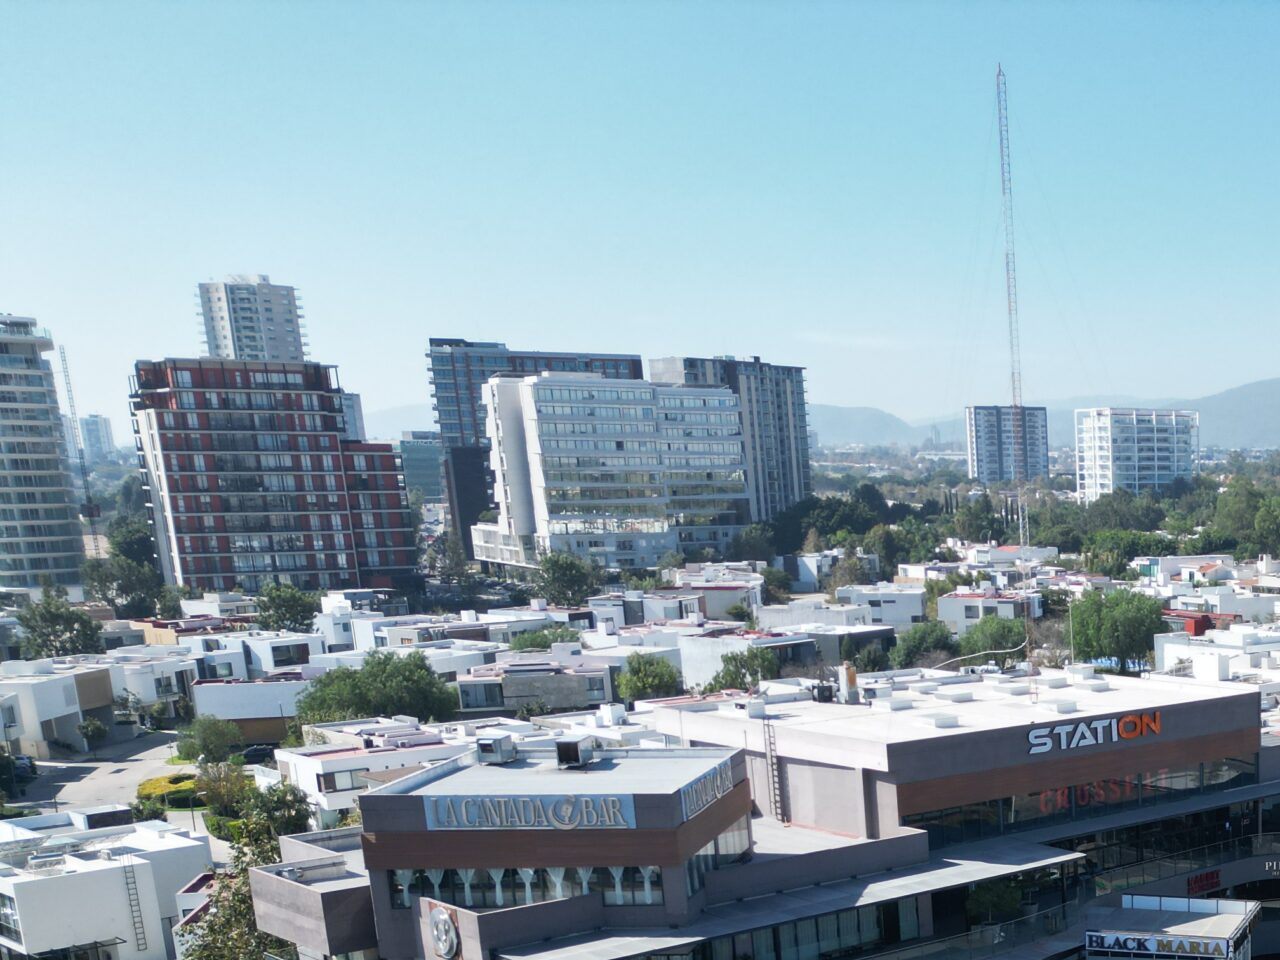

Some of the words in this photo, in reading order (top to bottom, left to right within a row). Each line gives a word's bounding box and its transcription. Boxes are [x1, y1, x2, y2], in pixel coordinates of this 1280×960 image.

[1028, 711, 1160, 754] STATION
[431, 797, 457, 827] LA
[461, 796, 548, 827] CANTADA
[581, 797, 628, 827] BAR
[1087, 934, 1150, 951] BLACK
[1156, 938, 1225, 956] MARIA
